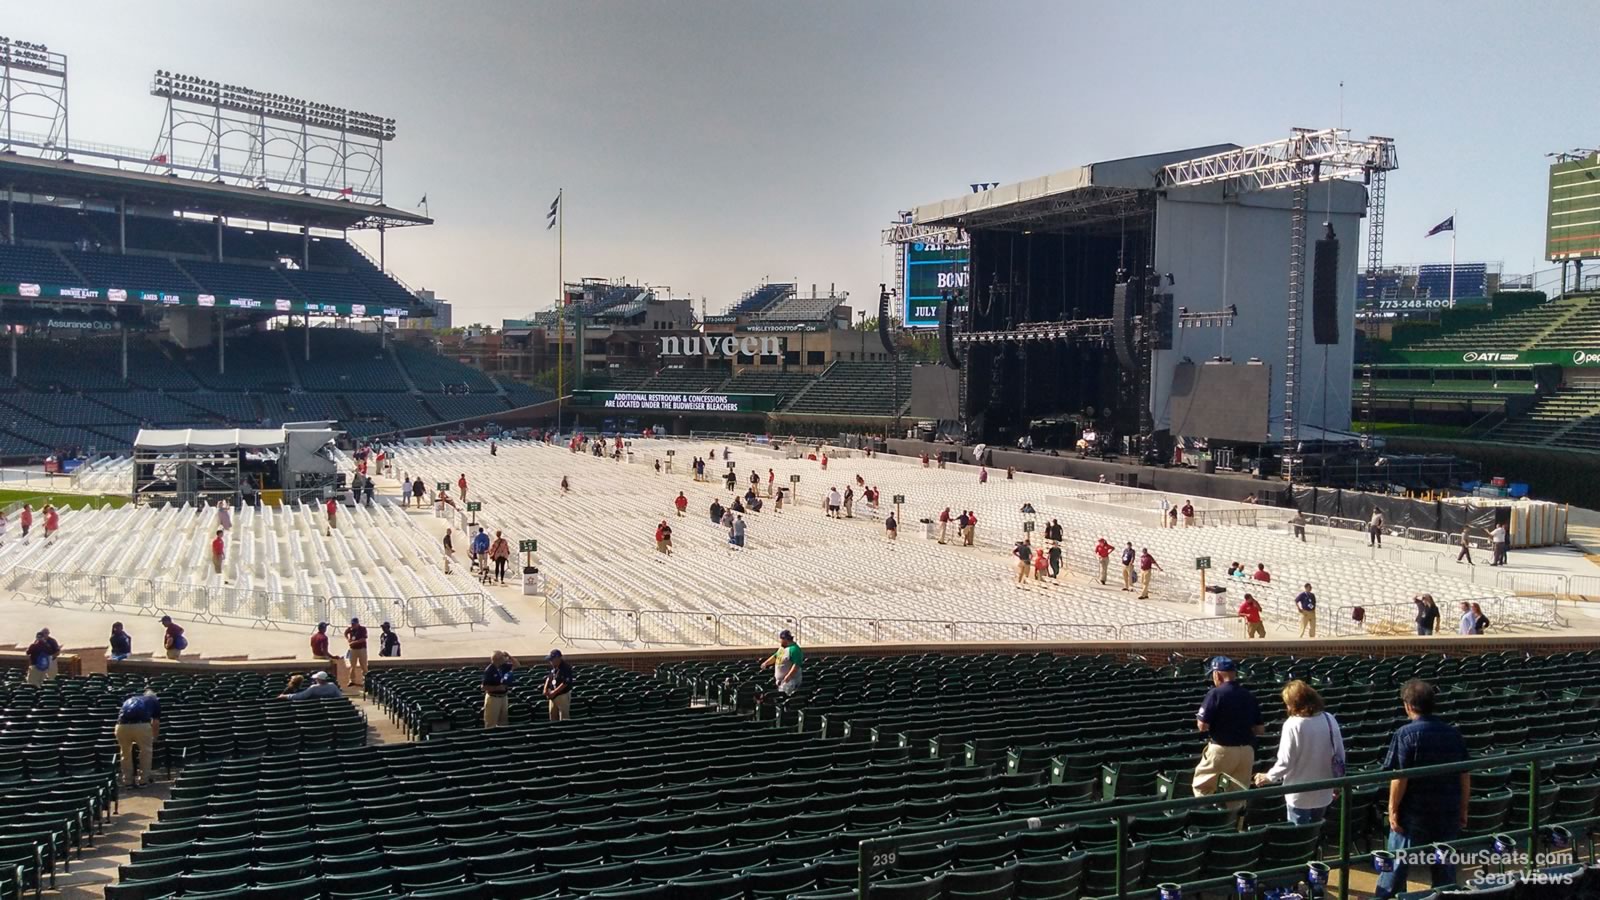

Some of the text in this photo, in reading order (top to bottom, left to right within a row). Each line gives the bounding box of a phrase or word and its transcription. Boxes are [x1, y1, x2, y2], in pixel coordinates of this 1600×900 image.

[140, 291, 180, 302] JAMES TAYLOR
[1379, 299, 1457, 309] 773-248-ROOF
[915, 306, 937, 317] JULY
[47, 319, 111, 330] Assurance Club
[660, 335, 783, 357] nuveen
[1477, 353, 1500, 361] ATI
[614, 393, 647, 401] ADDITIONAL
[648, 394, 682, 402] RESTROOMS
[689, 395, 728, 403] CONCESSIONS
[673, 402, 705, 410] BUDWEISER
[706, 403, 738, 411] BLEACHERS
[873, 852, 896, 867] 239
